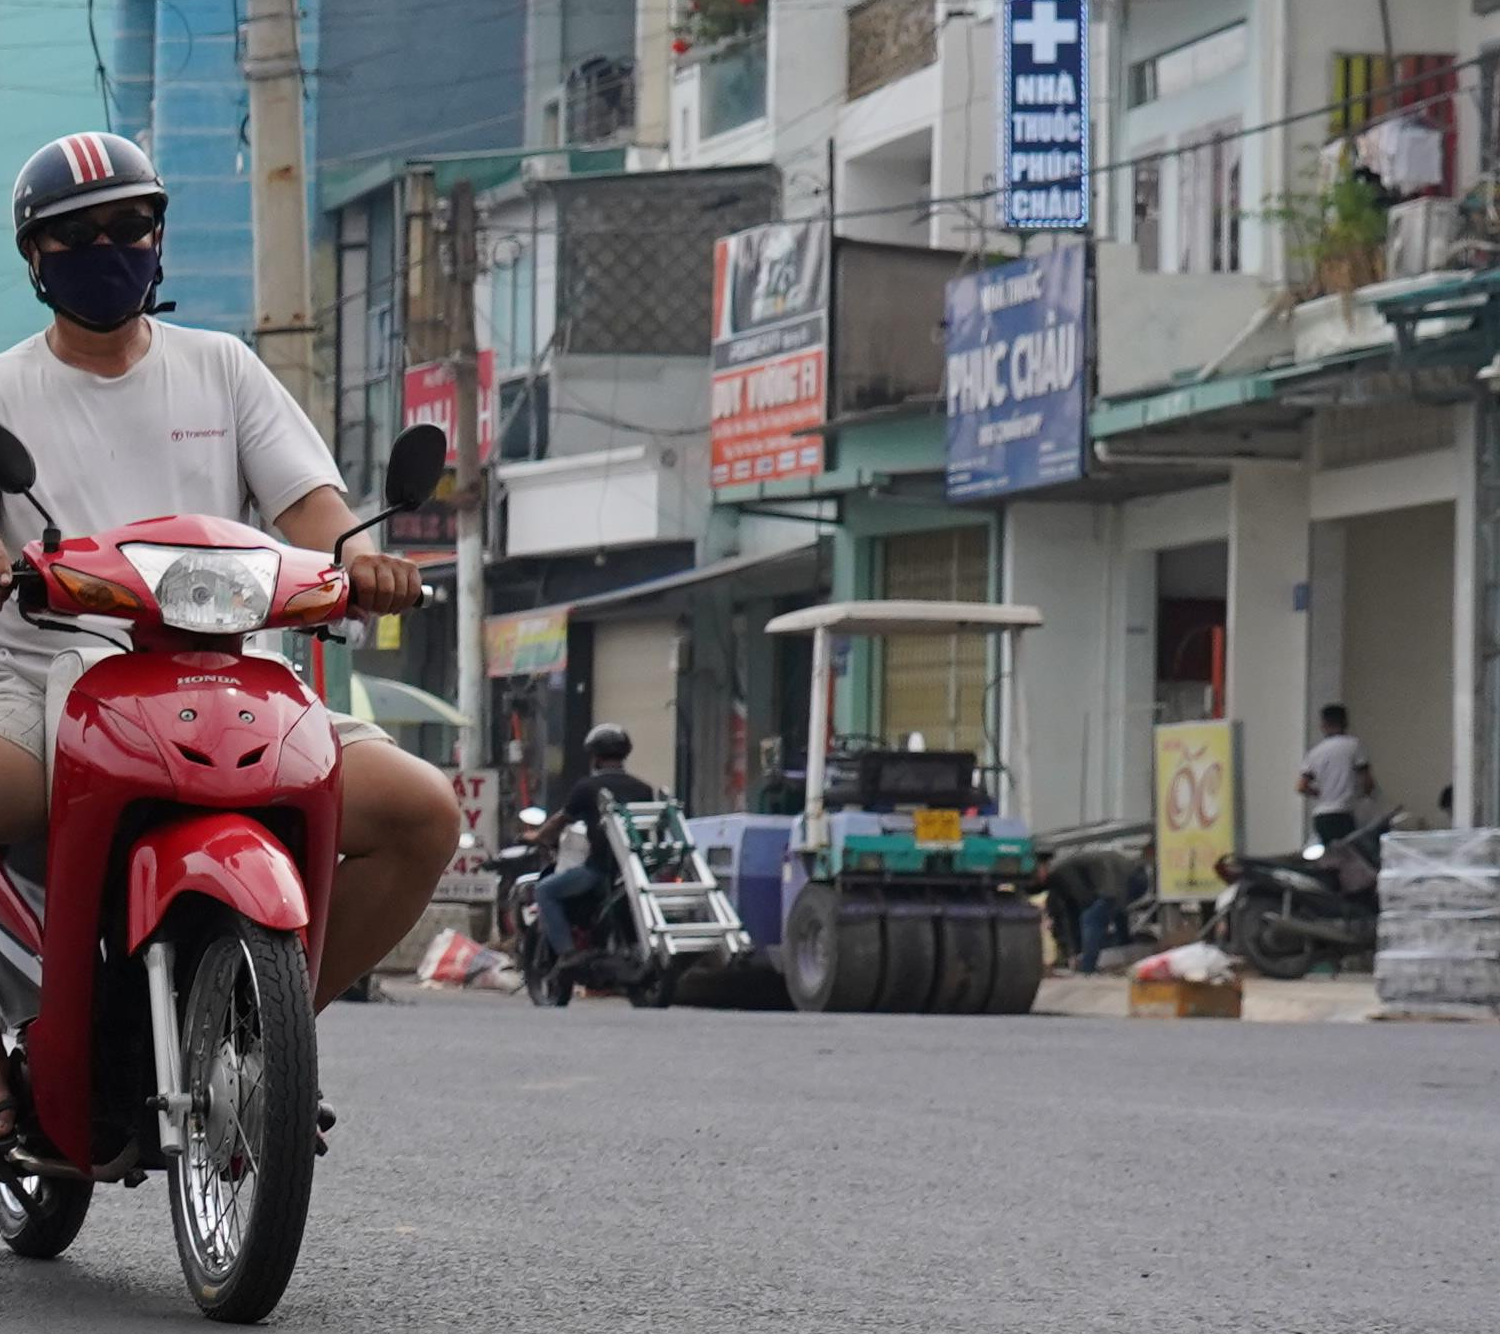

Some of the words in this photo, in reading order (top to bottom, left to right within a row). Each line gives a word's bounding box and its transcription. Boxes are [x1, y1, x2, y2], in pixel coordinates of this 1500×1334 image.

[1015, 69, 1077, 105] NHÀ
[1012, 104, 1081, 143] THUỐC
[1012, 147, 1081, 182] PHÚC
[1012, 184, 1081, 220] CHÂU
[947, 325, 1009, 416] PHÚC
[1010, 309, 1076, 403] CHÂU
[177, 675, 242, 686] HONDA
